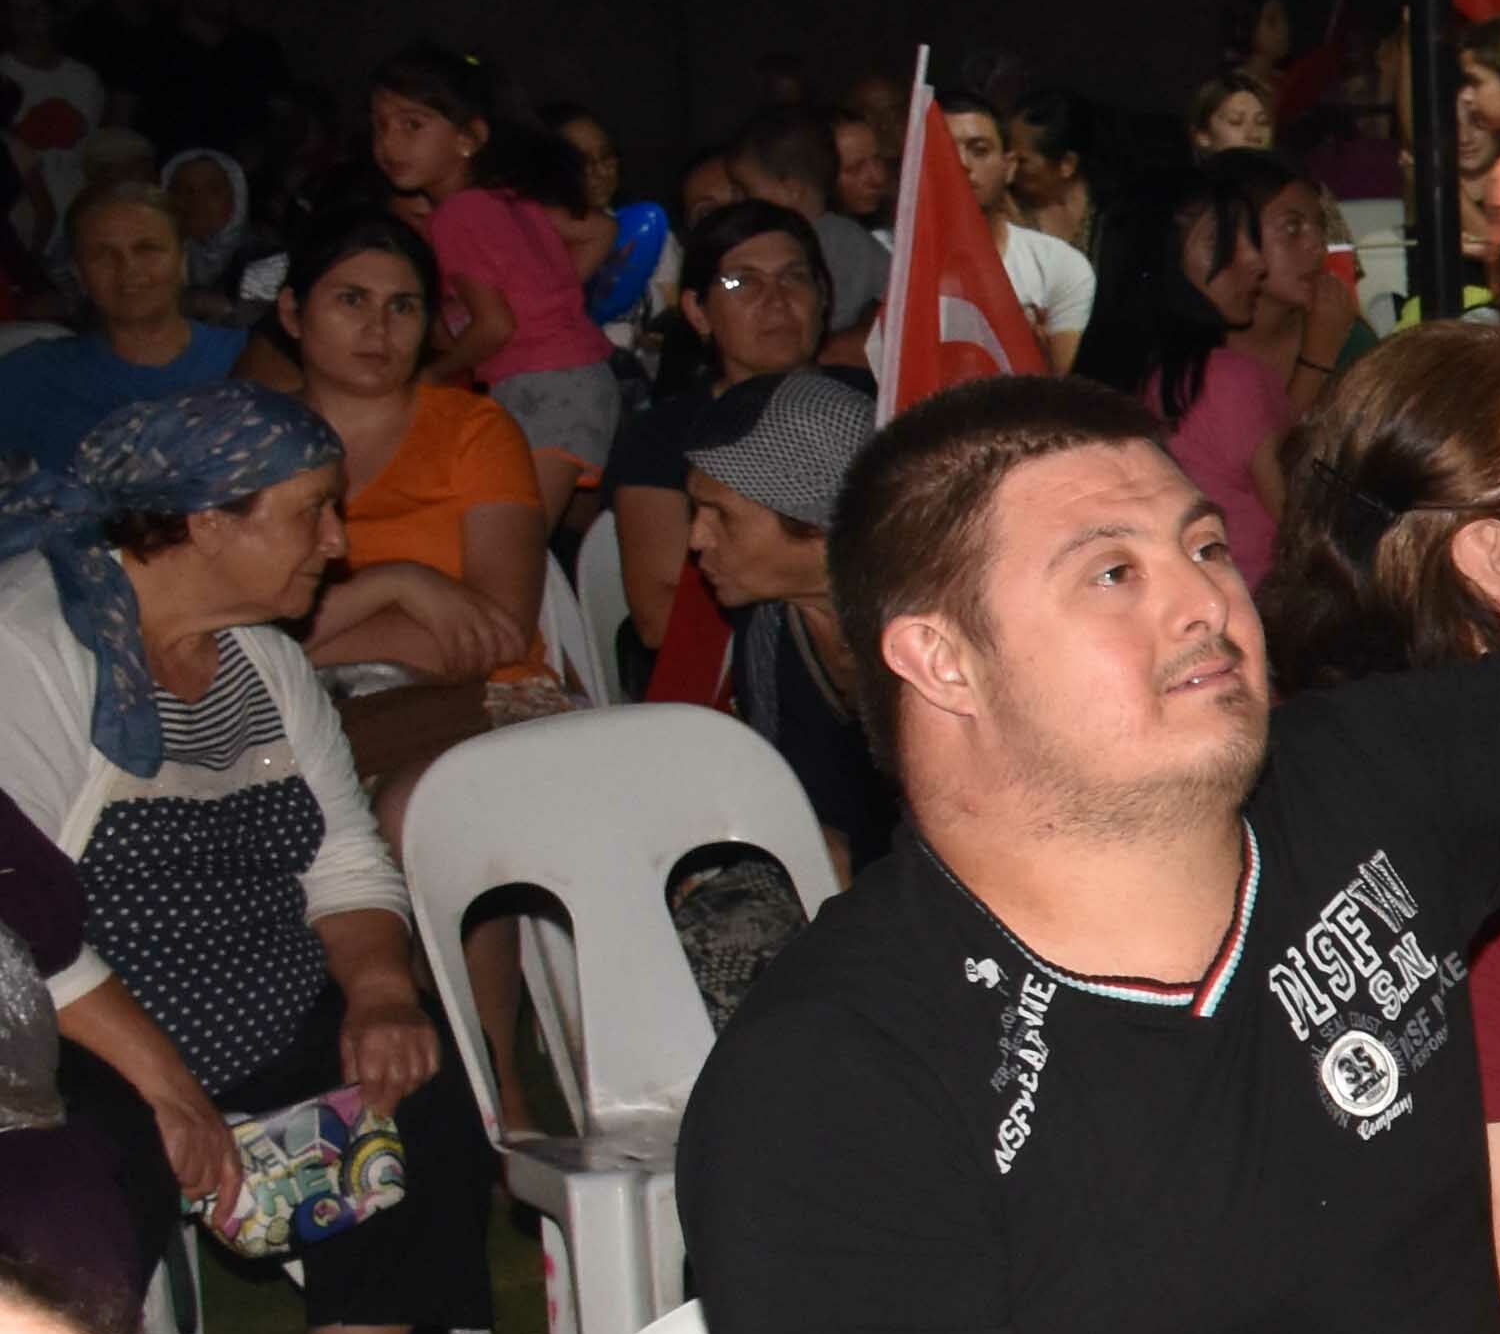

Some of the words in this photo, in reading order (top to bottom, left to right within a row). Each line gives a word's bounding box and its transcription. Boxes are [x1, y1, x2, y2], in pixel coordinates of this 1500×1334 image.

[1267, 848, 1421, 1043] NSFW
[1338, 1046, 1375, 1084] 35
[1356, 1091, 1415, 1142] Company
